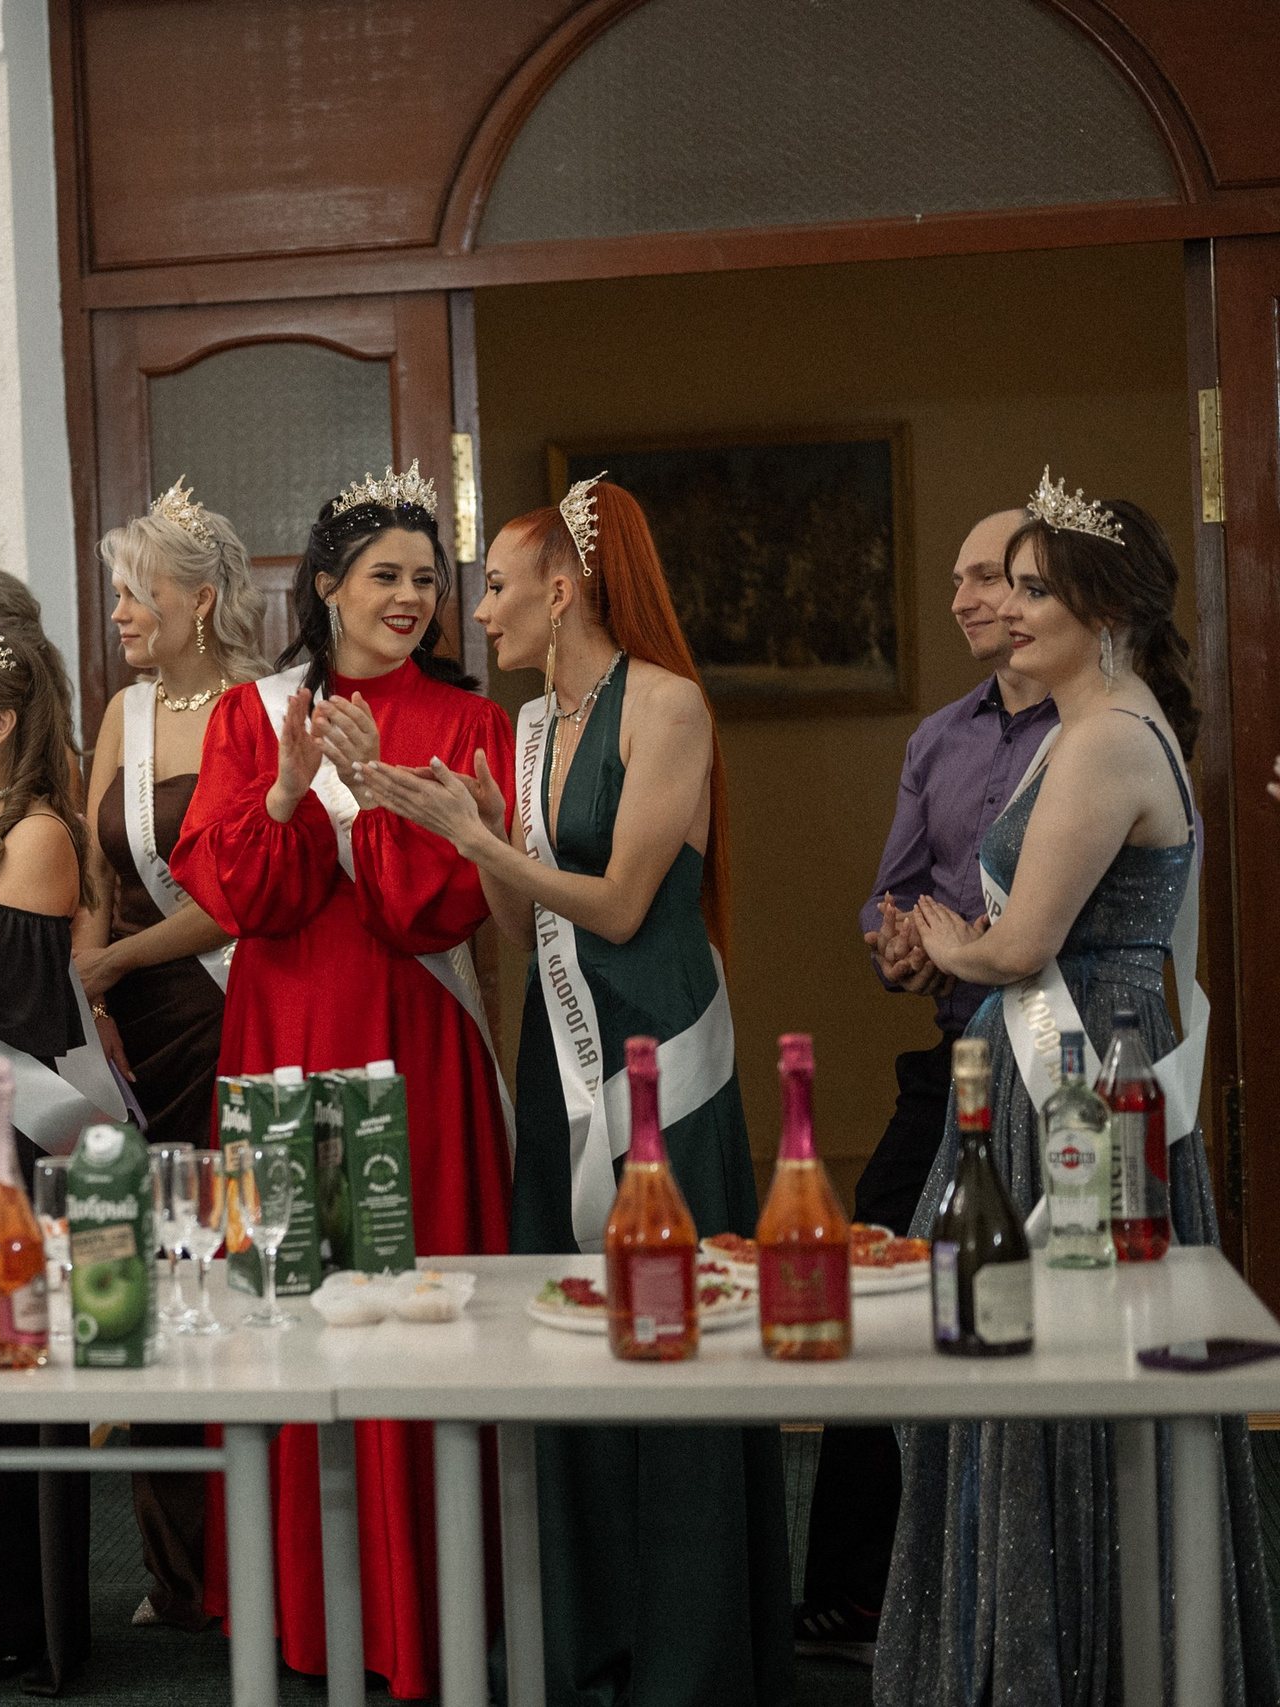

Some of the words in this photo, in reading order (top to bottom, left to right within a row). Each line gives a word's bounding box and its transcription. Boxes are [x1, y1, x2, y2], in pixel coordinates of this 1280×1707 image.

[521, 715, 546, 840] УЧАСТНИЦА
[547, 954, 598, 1069] «ДОРОГАЯ
[1048, 1151, 1096, 1164] MARTINI
